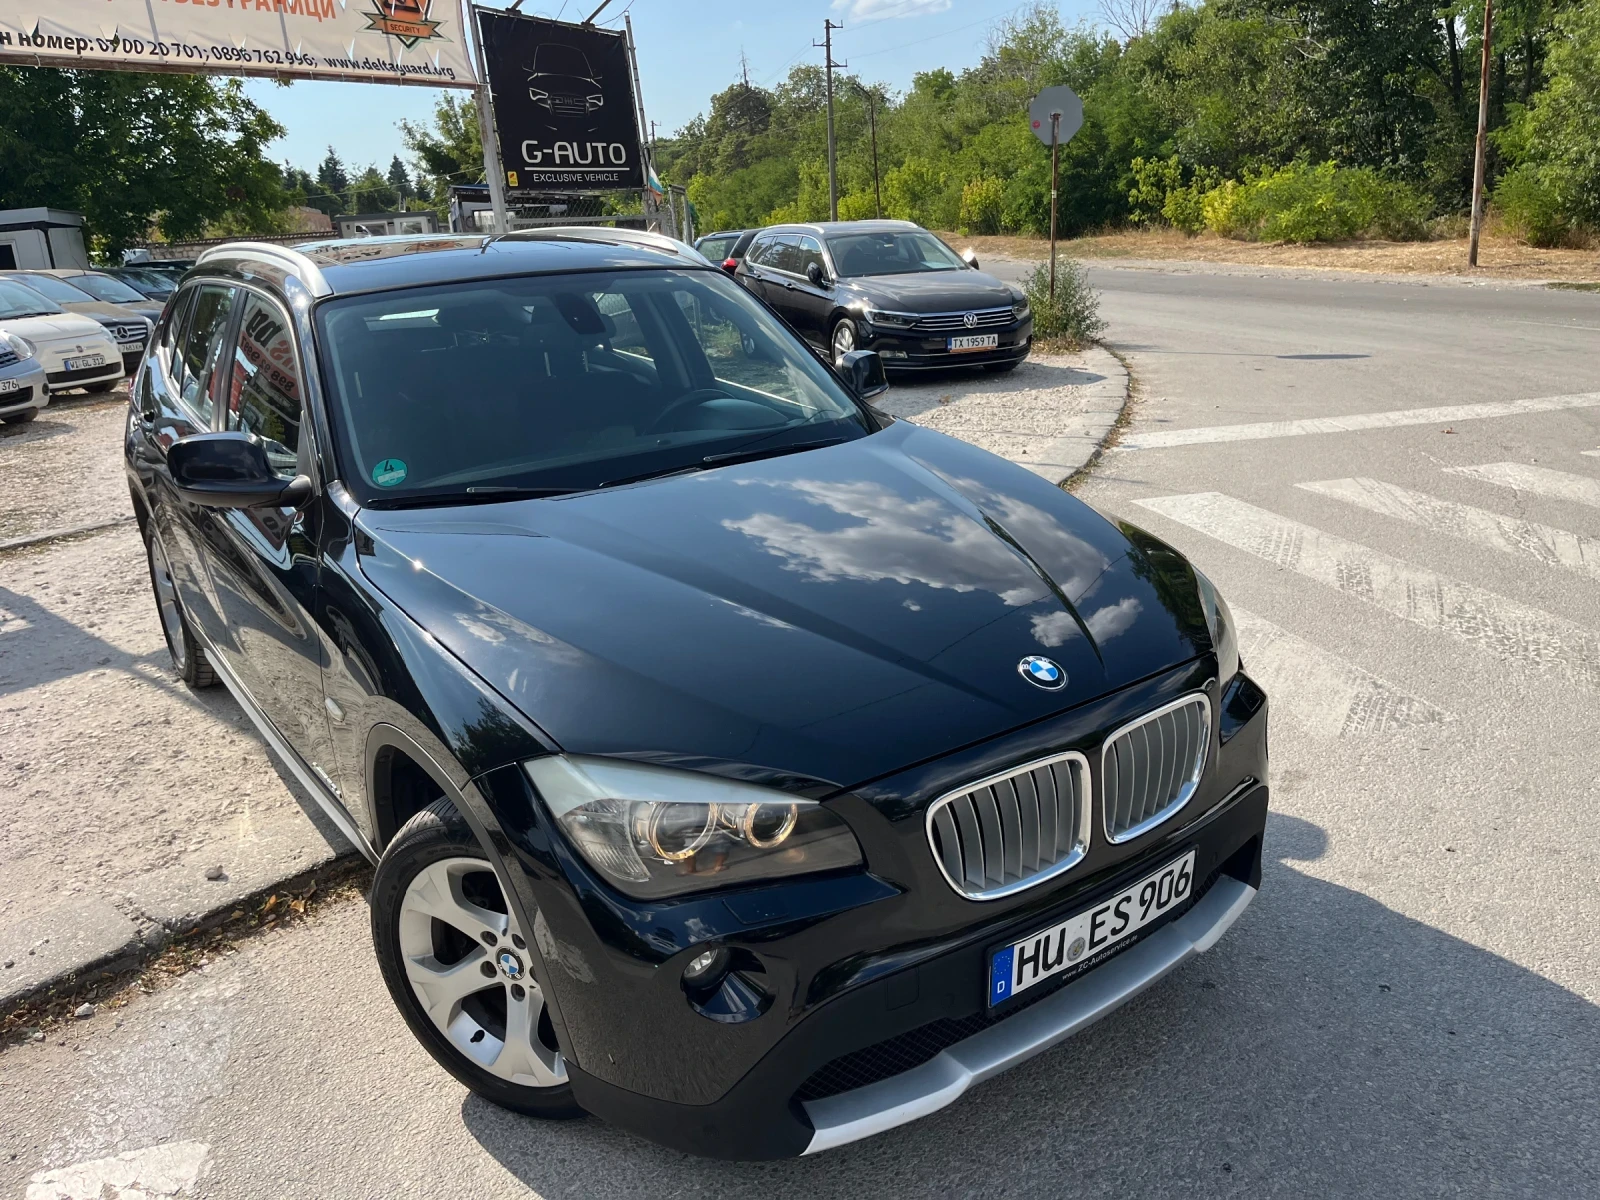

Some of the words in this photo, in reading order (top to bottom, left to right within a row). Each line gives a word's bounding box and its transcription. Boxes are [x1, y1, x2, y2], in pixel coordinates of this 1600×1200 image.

[390, 23, 420, 34] SECURITY
[18, 32, 94, 55] номер:
[147, 40, 170, 56] 20
[171, 42, 210, 62] 701;
[210, 46, 252, 62] 0896
[252, 49, 284, 65] 762
[285, 51, 318, 68] 996;
[323, 57, 456, 80] www.deltaguard.org
[521, 140, 627, 165] G-AUTO
[533, 173, 583, 182] EXCLUSIVE
[585, 173, 619, 182] VEHICLE
[953, 338, 964, 348] TX
[966, 337, 985, 347] 1959
[986, 335, 997, 345] TA
[92, 357, 105, 366] 312
[1, 380, 17, 391] 376
[384, 460, 395, 472] 4
[1016, 927, 1066, 987] HU
[1088, 895, 1132, 951] ES
[1139, 859, 1192, 922] 906
[997, 981, 1005, 993] D
